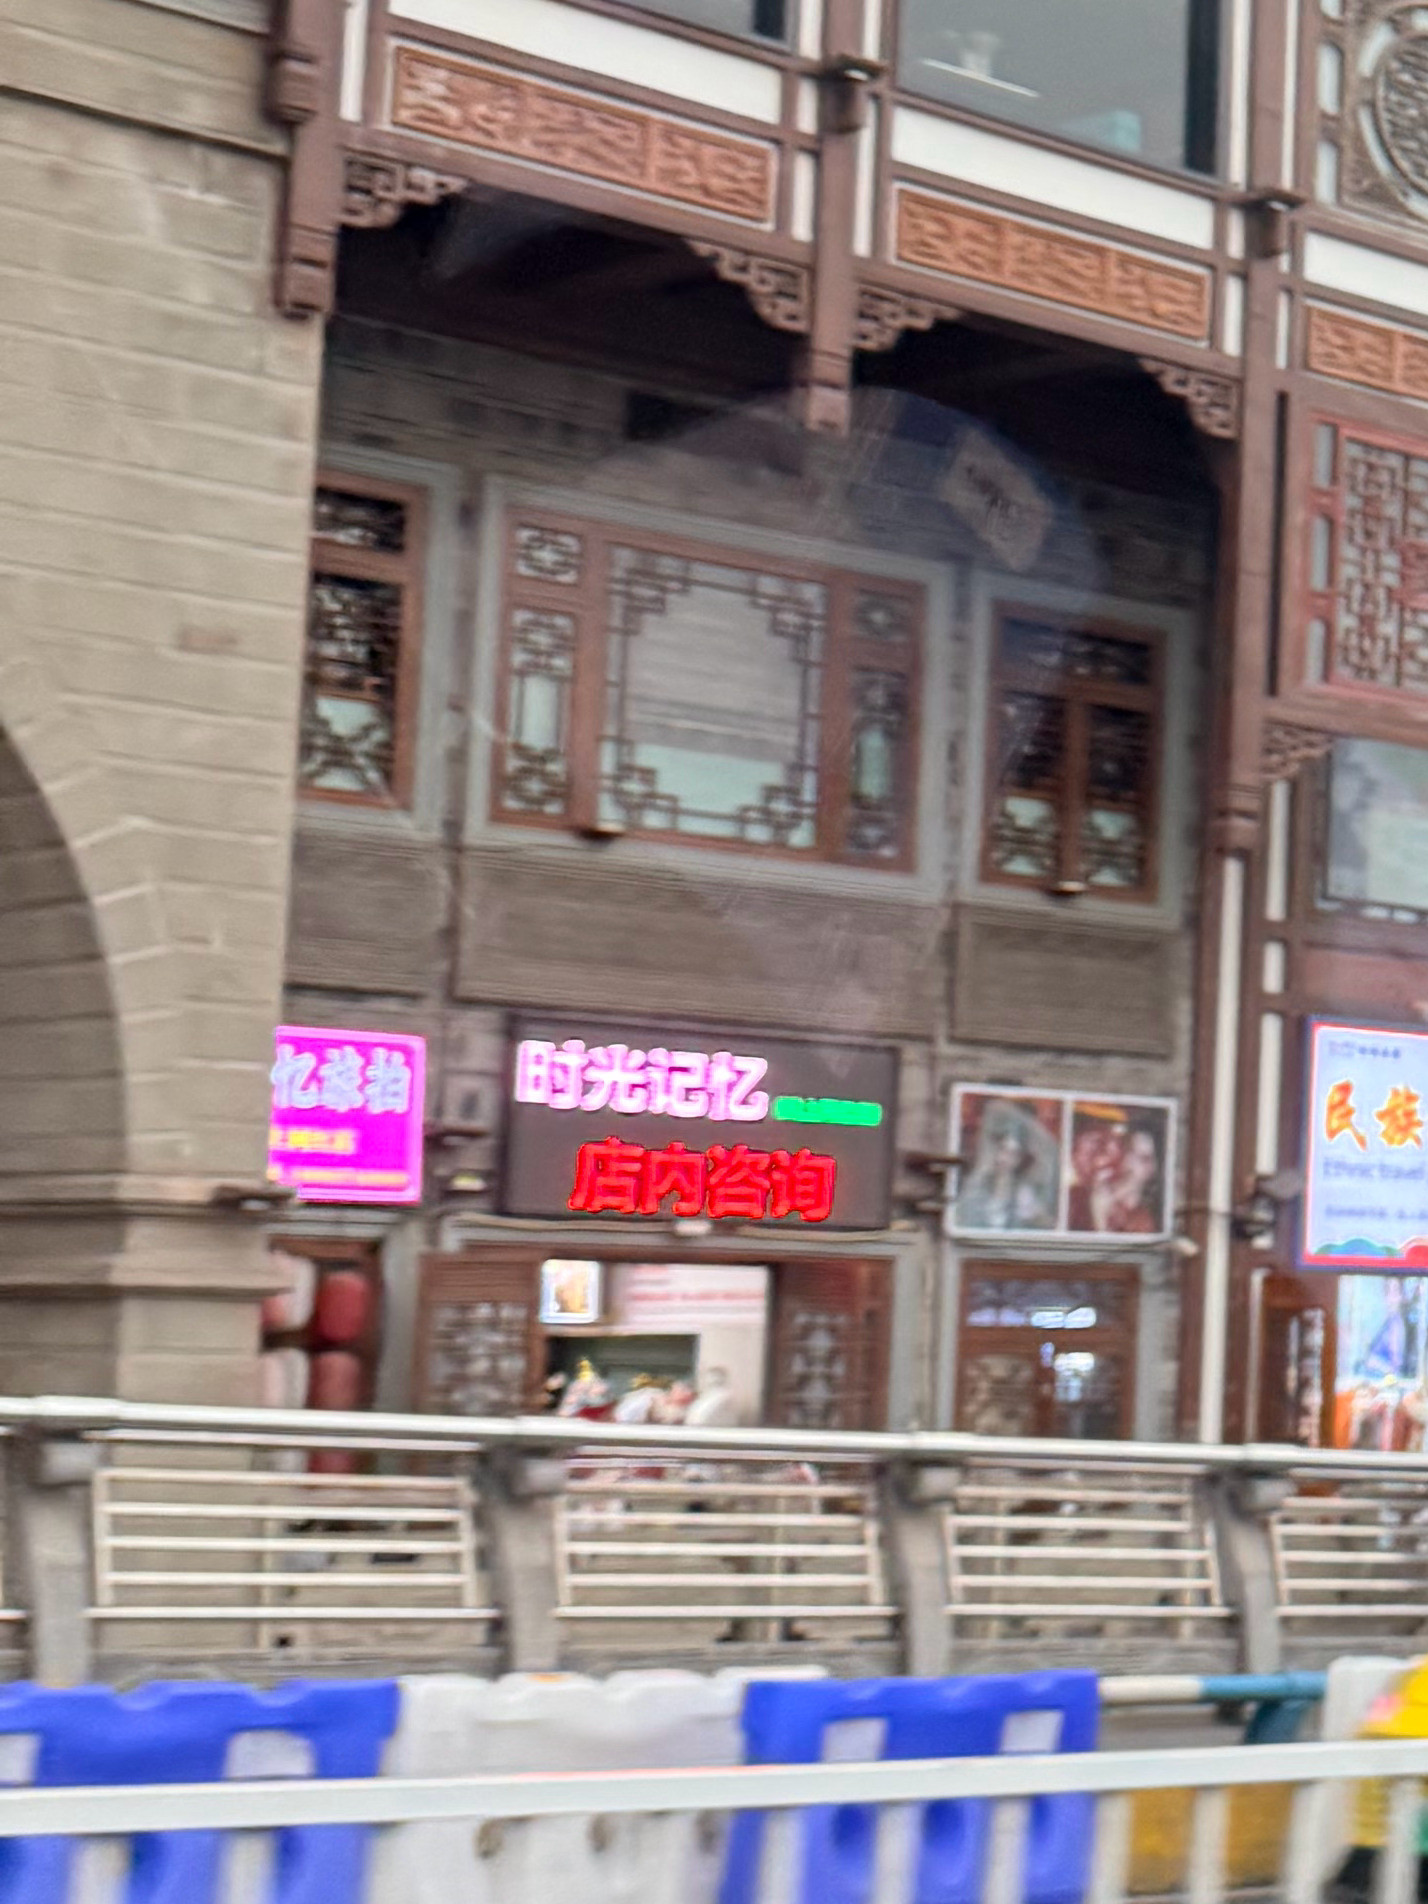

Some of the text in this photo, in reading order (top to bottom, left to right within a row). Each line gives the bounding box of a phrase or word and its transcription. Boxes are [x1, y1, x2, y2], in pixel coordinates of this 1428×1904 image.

[515, 1039, 770, 1122] 时光记忆
[567, 1136, 837, 1223] 店内咨询
